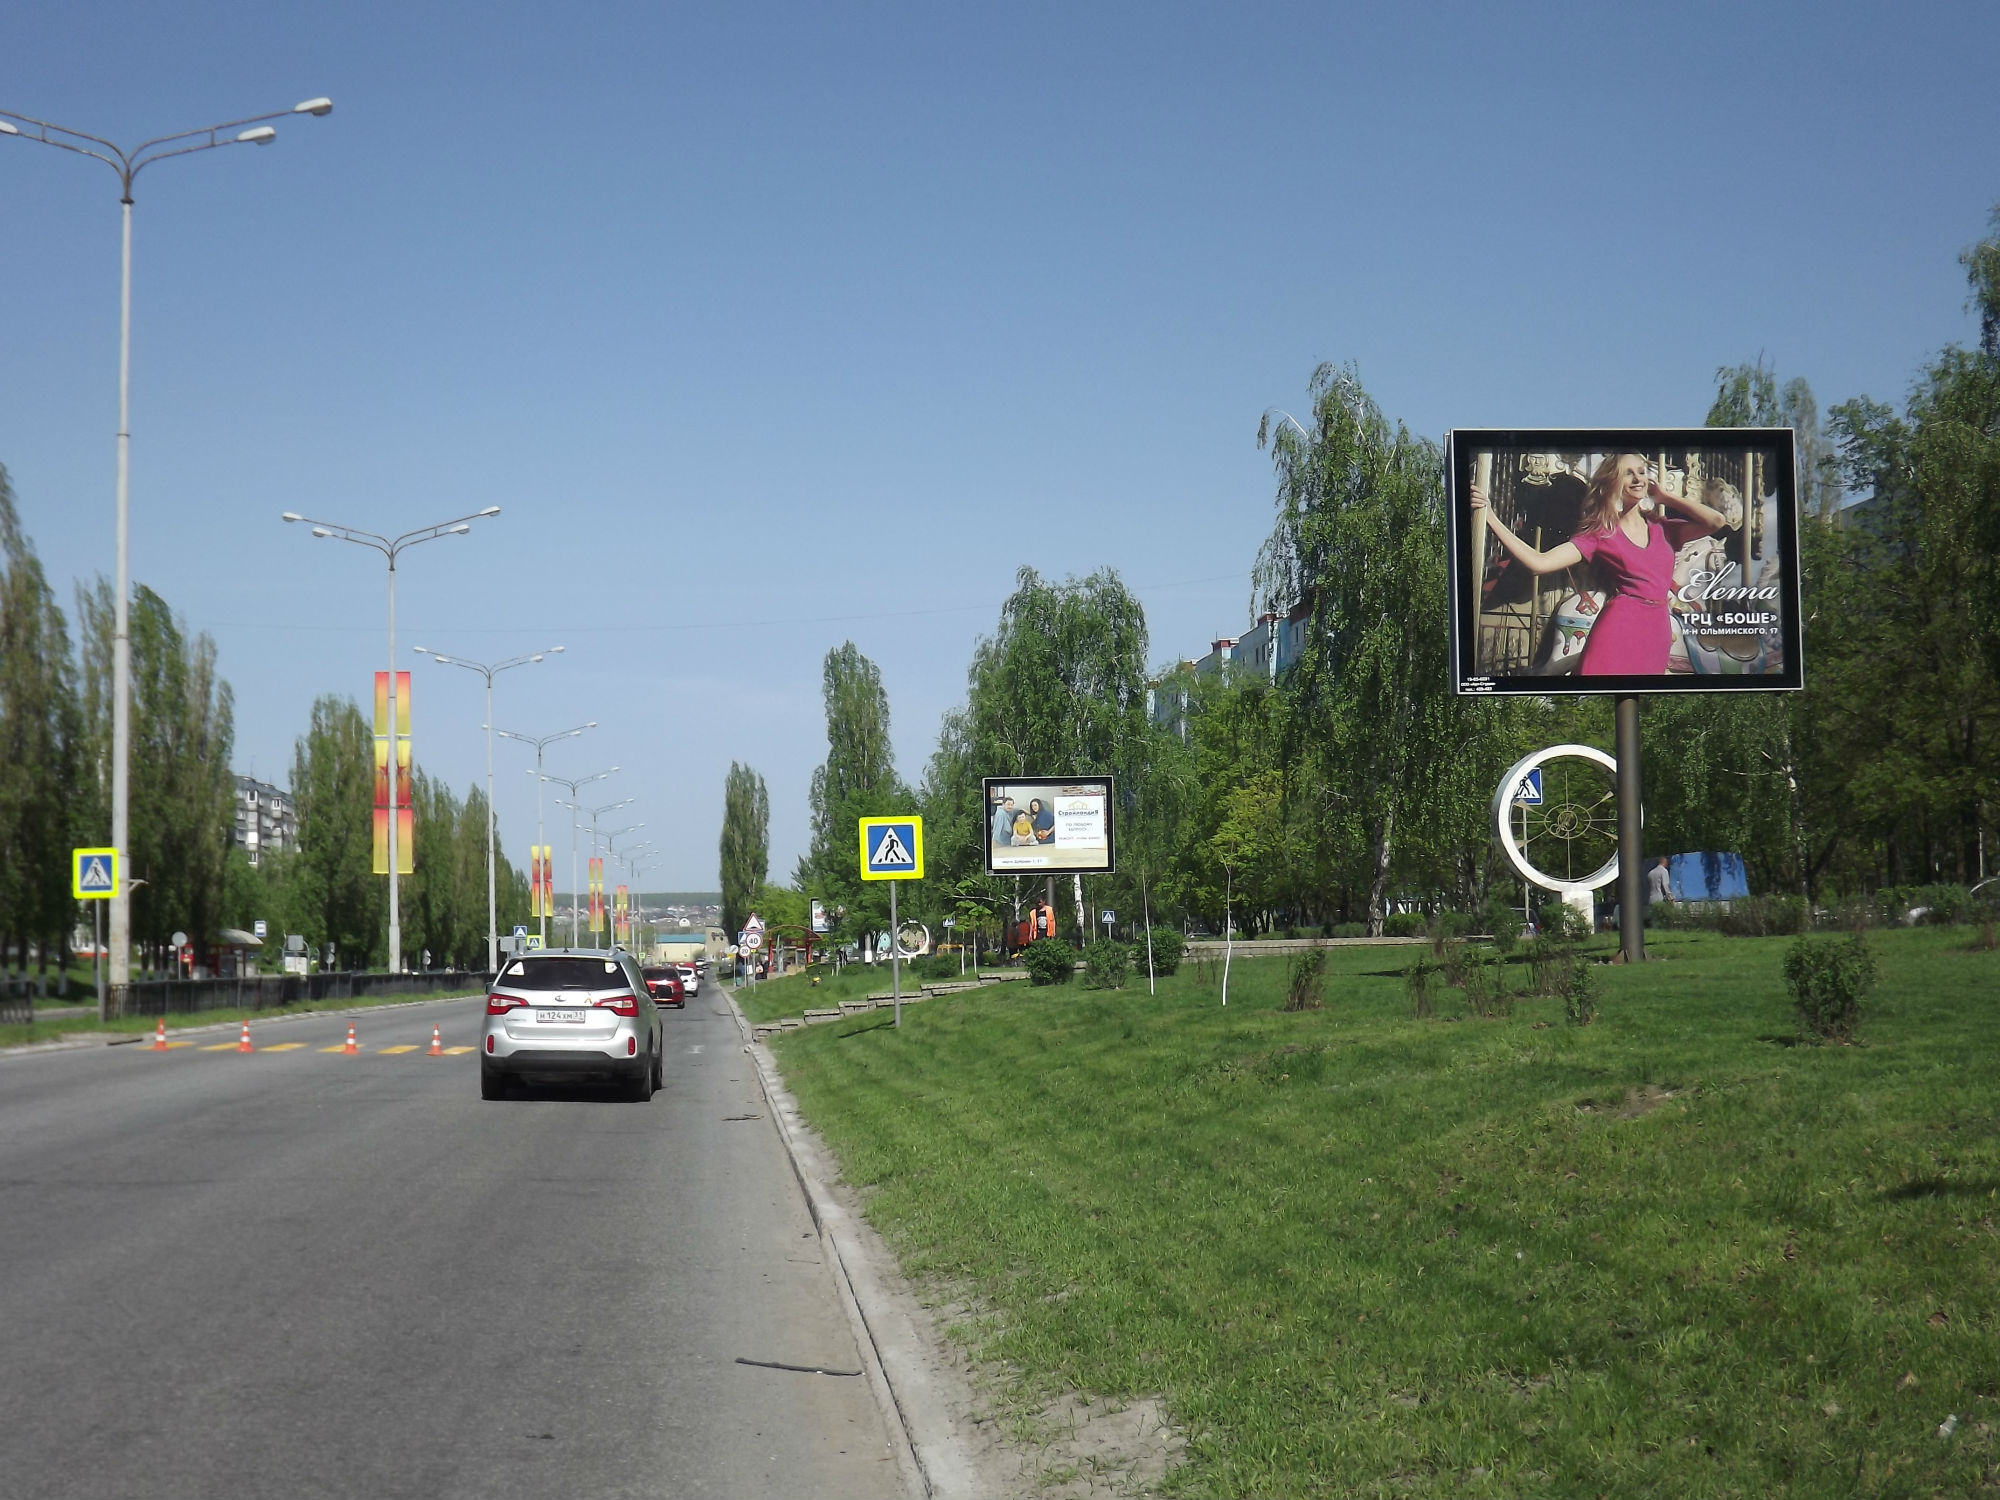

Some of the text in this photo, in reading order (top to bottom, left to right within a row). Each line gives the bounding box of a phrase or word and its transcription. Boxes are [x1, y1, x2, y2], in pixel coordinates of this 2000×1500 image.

[1677, 561, 1779, 603] Elema
[1681, 612, 1778, 626] ТРЦ «БОШЕ»
